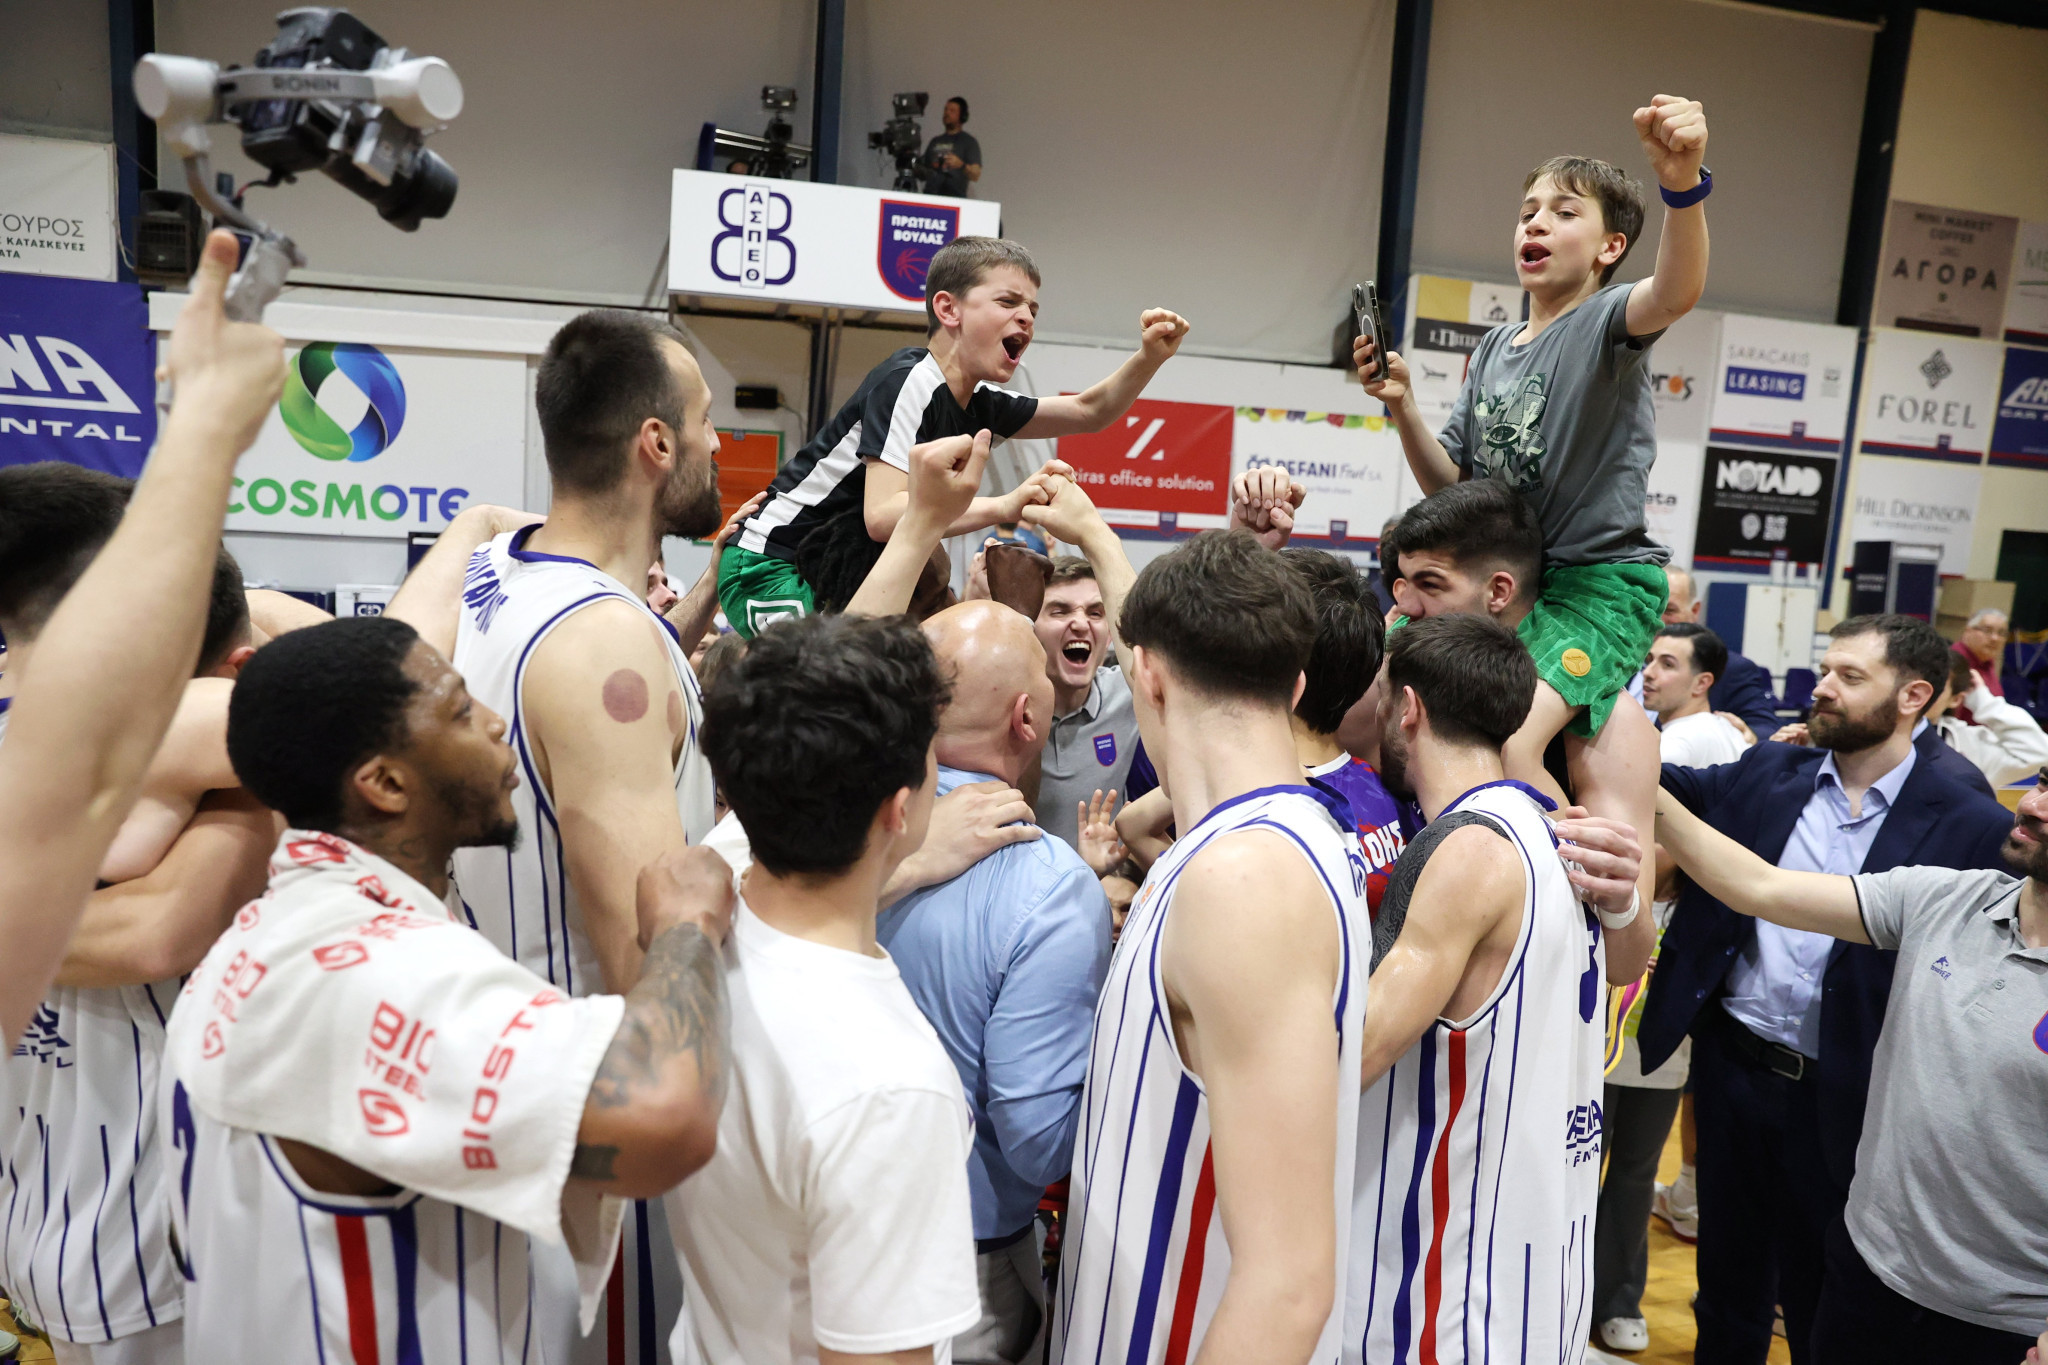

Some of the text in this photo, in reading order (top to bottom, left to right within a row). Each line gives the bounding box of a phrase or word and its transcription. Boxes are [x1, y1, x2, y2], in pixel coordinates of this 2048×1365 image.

[891, 214, 948, 232] ΠΡΩΤΕΑΣ
[6, 237, 86, 252] ΚΑΤΑΣΚΕΥΕΣ
[893, 229, 944, 246] ΒΟΥΛΑΣ
[1891, 257, 1998, 291] ΑΓΟΡΑ
[1727, 371, 1803, 395] LEASING
[1877, 394, 1977, 430] FOREL
[0, 417, 141, 442] NTAL
[1109, 469, 1153, 487] office
[1157, 473, 1215, 492] solution
